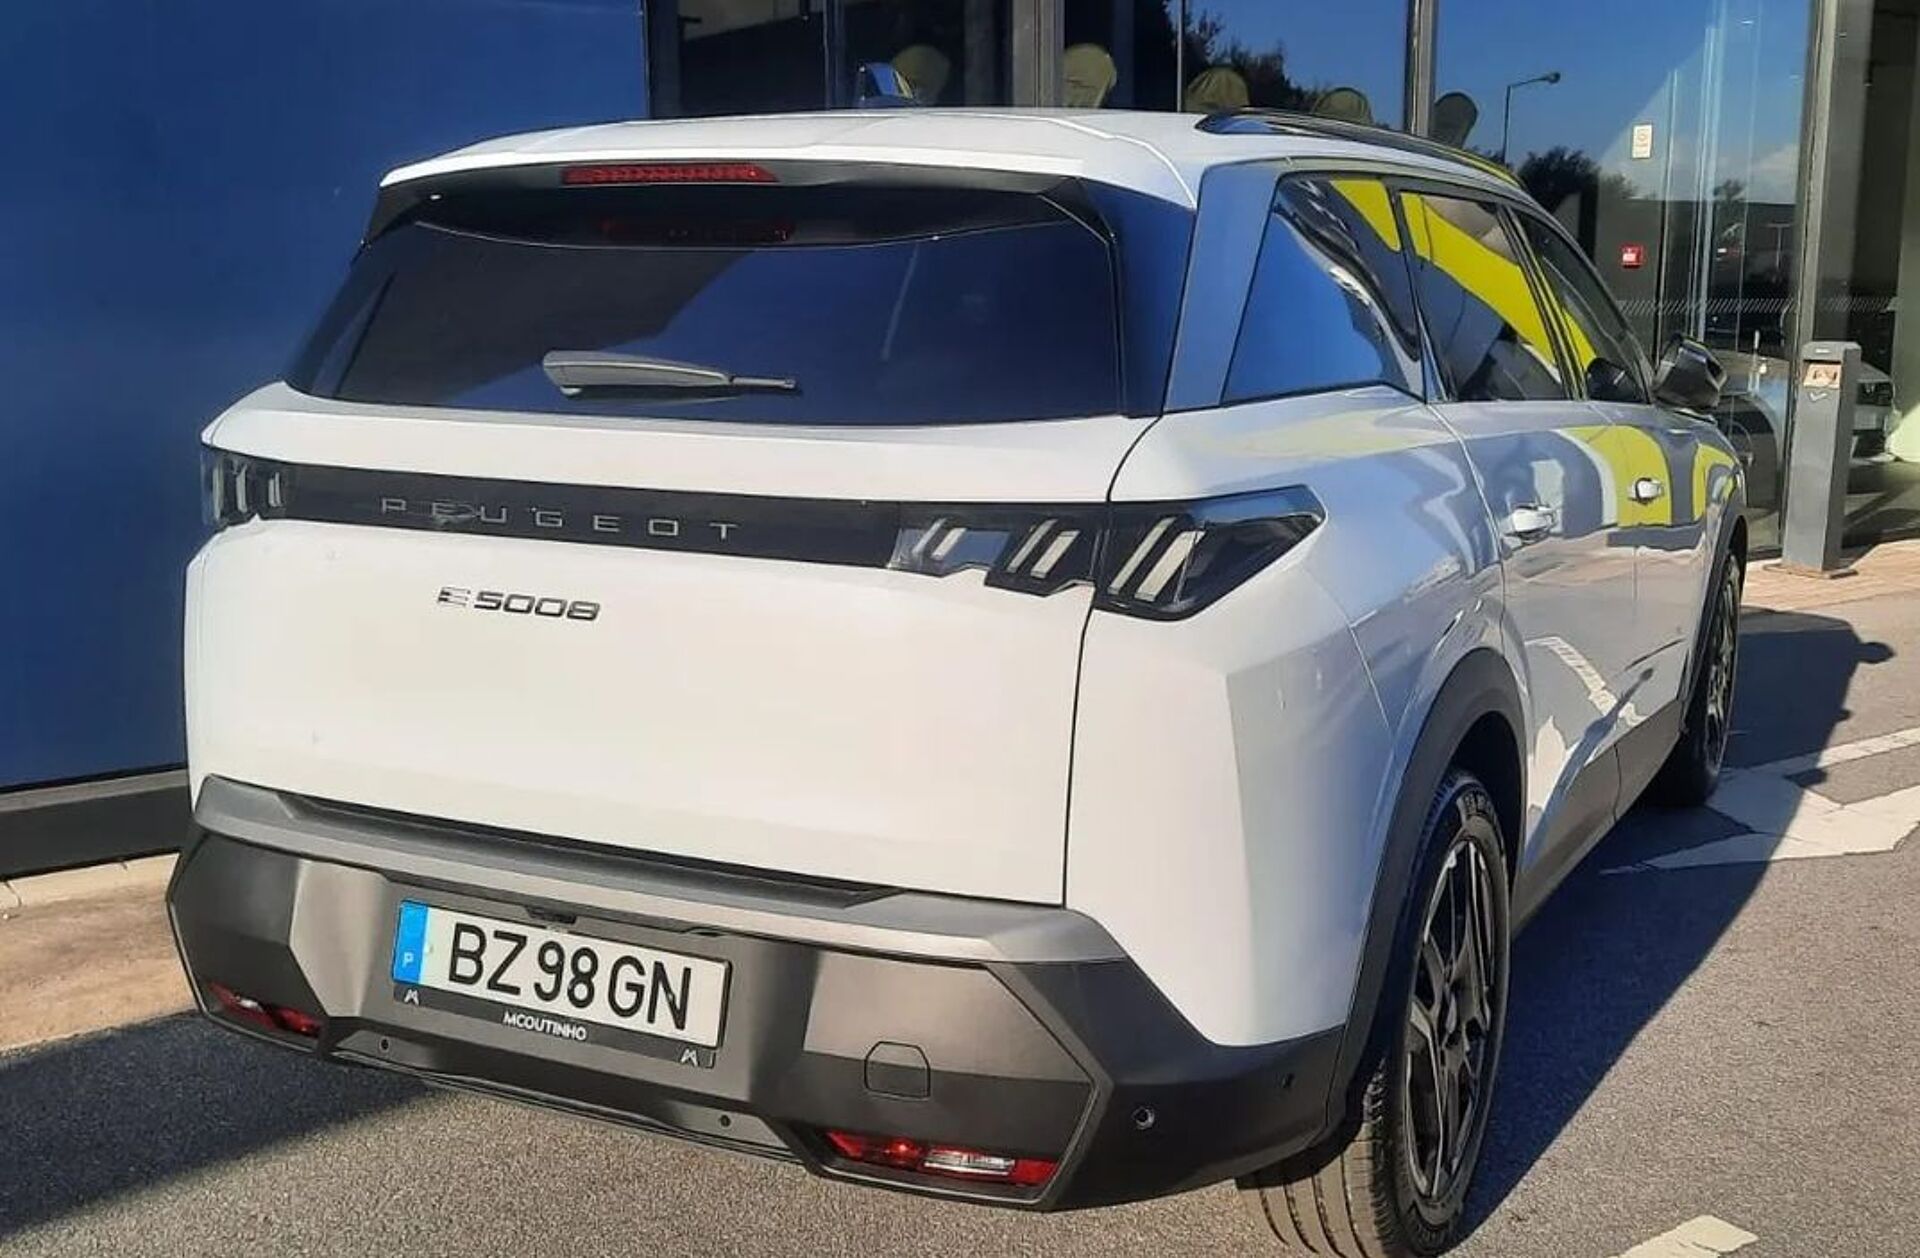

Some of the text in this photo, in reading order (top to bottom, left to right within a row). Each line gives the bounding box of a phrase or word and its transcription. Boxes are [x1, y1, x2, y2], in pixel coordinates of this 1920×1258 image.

[381, 497, 737, 540] PEUGEOT
[402, 952, 415, 968] P
[503, 1010, 588, 1041] MCOUTINHO
